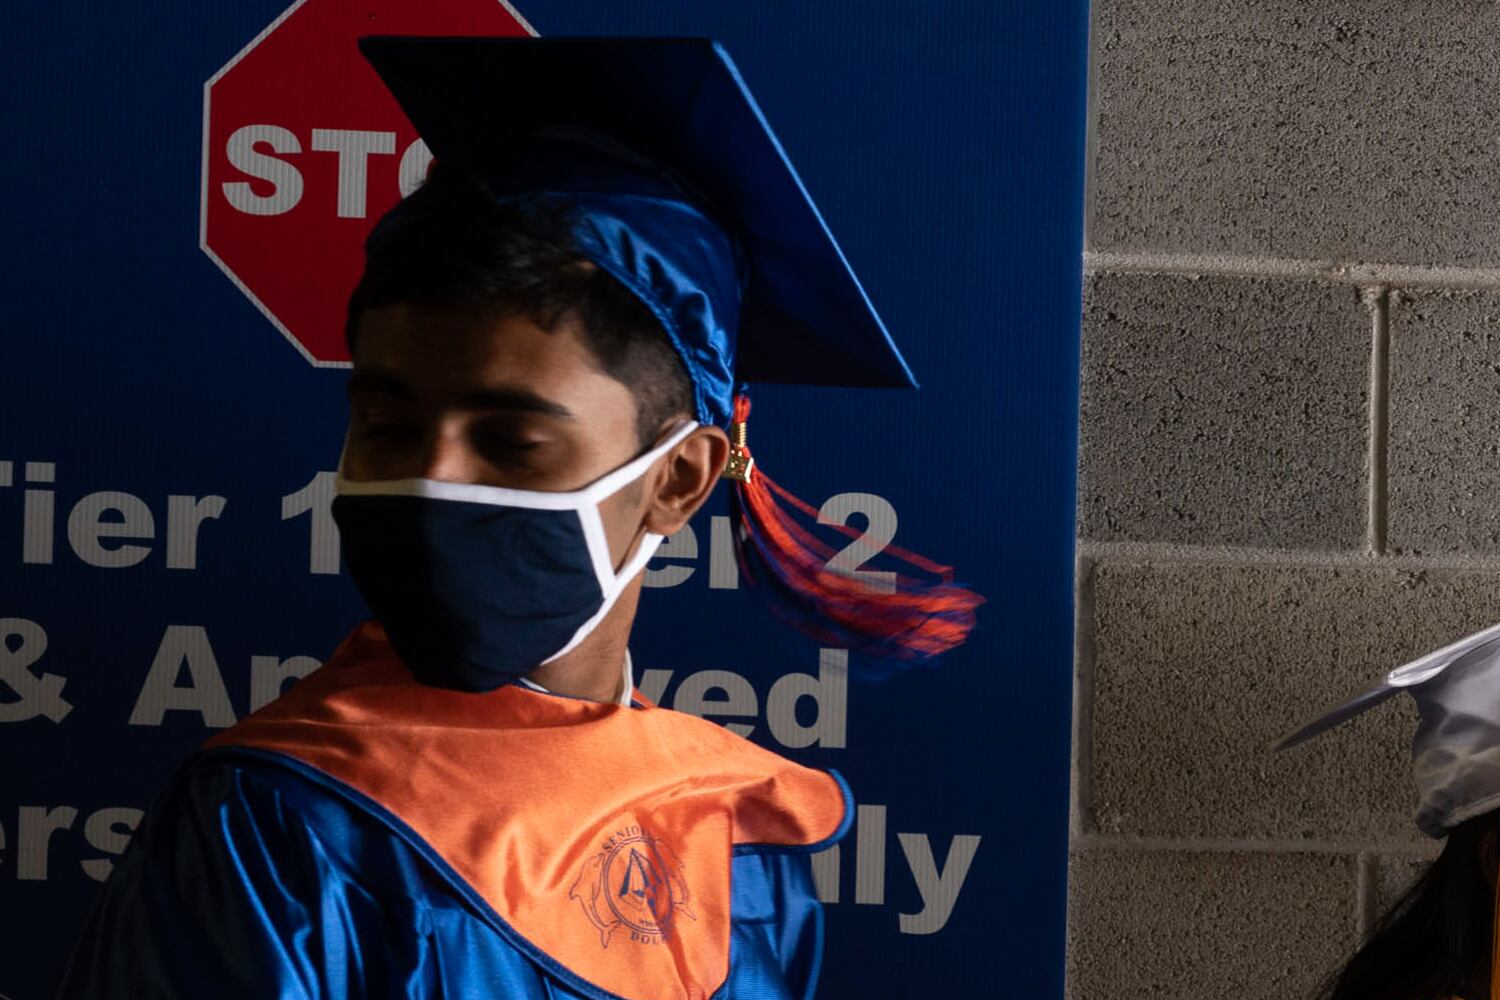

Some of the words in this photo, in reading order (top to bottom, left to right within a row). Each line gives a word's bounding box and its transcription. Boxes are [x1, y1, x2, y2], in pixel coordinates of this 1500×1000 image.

[221, 124, 436, 219] ST
[0, 460, 227, 570] ier
[281, 470, 341, 575] 1
[816, 492, 899, 596] 2
